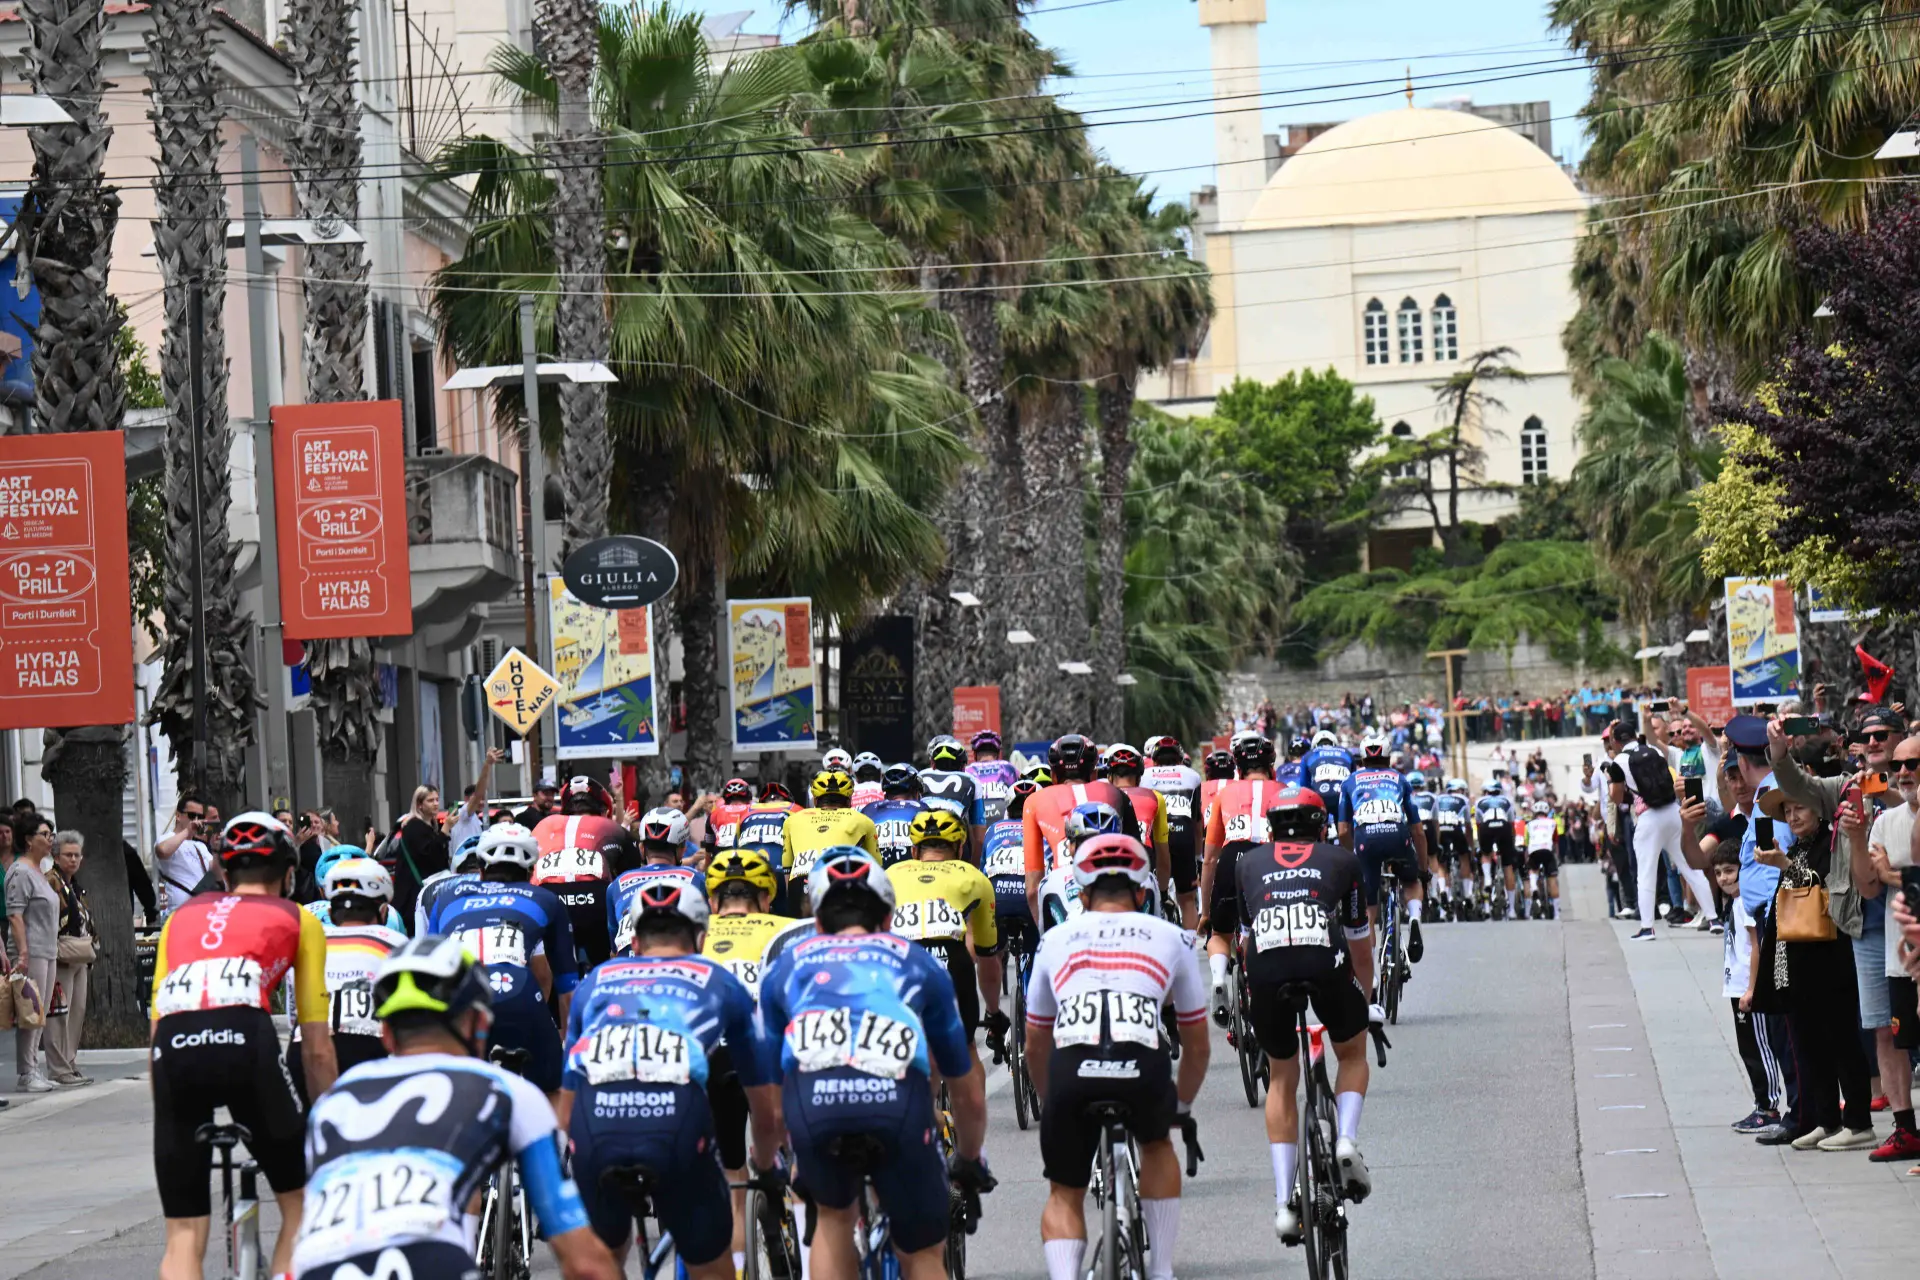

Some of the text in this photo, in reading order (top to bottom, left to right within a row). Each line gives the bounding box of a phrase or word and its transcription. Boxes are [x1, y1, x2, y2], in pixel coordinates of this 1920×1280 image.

[305, 440, 331, 453] ART
[305, 450, 368, 463] EXPLORA
[305, 461, 369, 475] FESTIVAL
[0, 476, 32, 490] ART
[0, 488, 79, 504] EXPLORA
[0, 502, 79, 518] FESTIVAL
[313, 508, 367, 523] 10 21
[321, 522, 361, 536] PRILL
[316, 548, 334, 557] Porti
[9, 560, 75, 578] 10 21
[580, 571, 658, 585] GIULIA
[18, 578, 68, 595] PRILL
[319, 580, 371, 596] HYRJA
[321, 595, 370, 610] FALAS
[12, 611, 34, 620] Porti
[40, 608, 76, 618] Durrësit
[15, 651, 80, 669] HYRJA
[18, 669, 79, 687] FALAS
[510, 661, 527, 724] HOTEL
[846, 680, 907, 693] ENVY
[528, 684, 553, 713] NAIS
[1229, 814, 1246, 831] 85
[542, 849, 597, 869] 87 87
[793, 850, 816, 868] 184
[989, 849, 1015, 867] 144
[1262, 868, 1322, 884] TUDOR
[454, 884, 534, 898] groupama
[1272, 889, 1309, 899] TUDOR
[463, 896, 498, 910] FDJ
[927, 900, 961, 926] 183
[1293, 905, 1327, 930] 195
[494, 926, 518, 948] 77
[1099, 927, 1152, 940] UBS
[166, 963, 192, 995] 44
[220, 958, 251, 987] 44
[1114, 993, 1155, 1029] 135
[799, 1008, 915, 1061] 148 148
[590, 1023, 684, 1064] 147 147
[813, 1078, 896, 1094] RENSON
[595, 1091, 675, 1106] RENSON
[812, 1090, 898, 1106] OUTDOOR
[594, 1105, 676, 1118] OUTDOOR
[371, 1164, 438, 1212] 122
